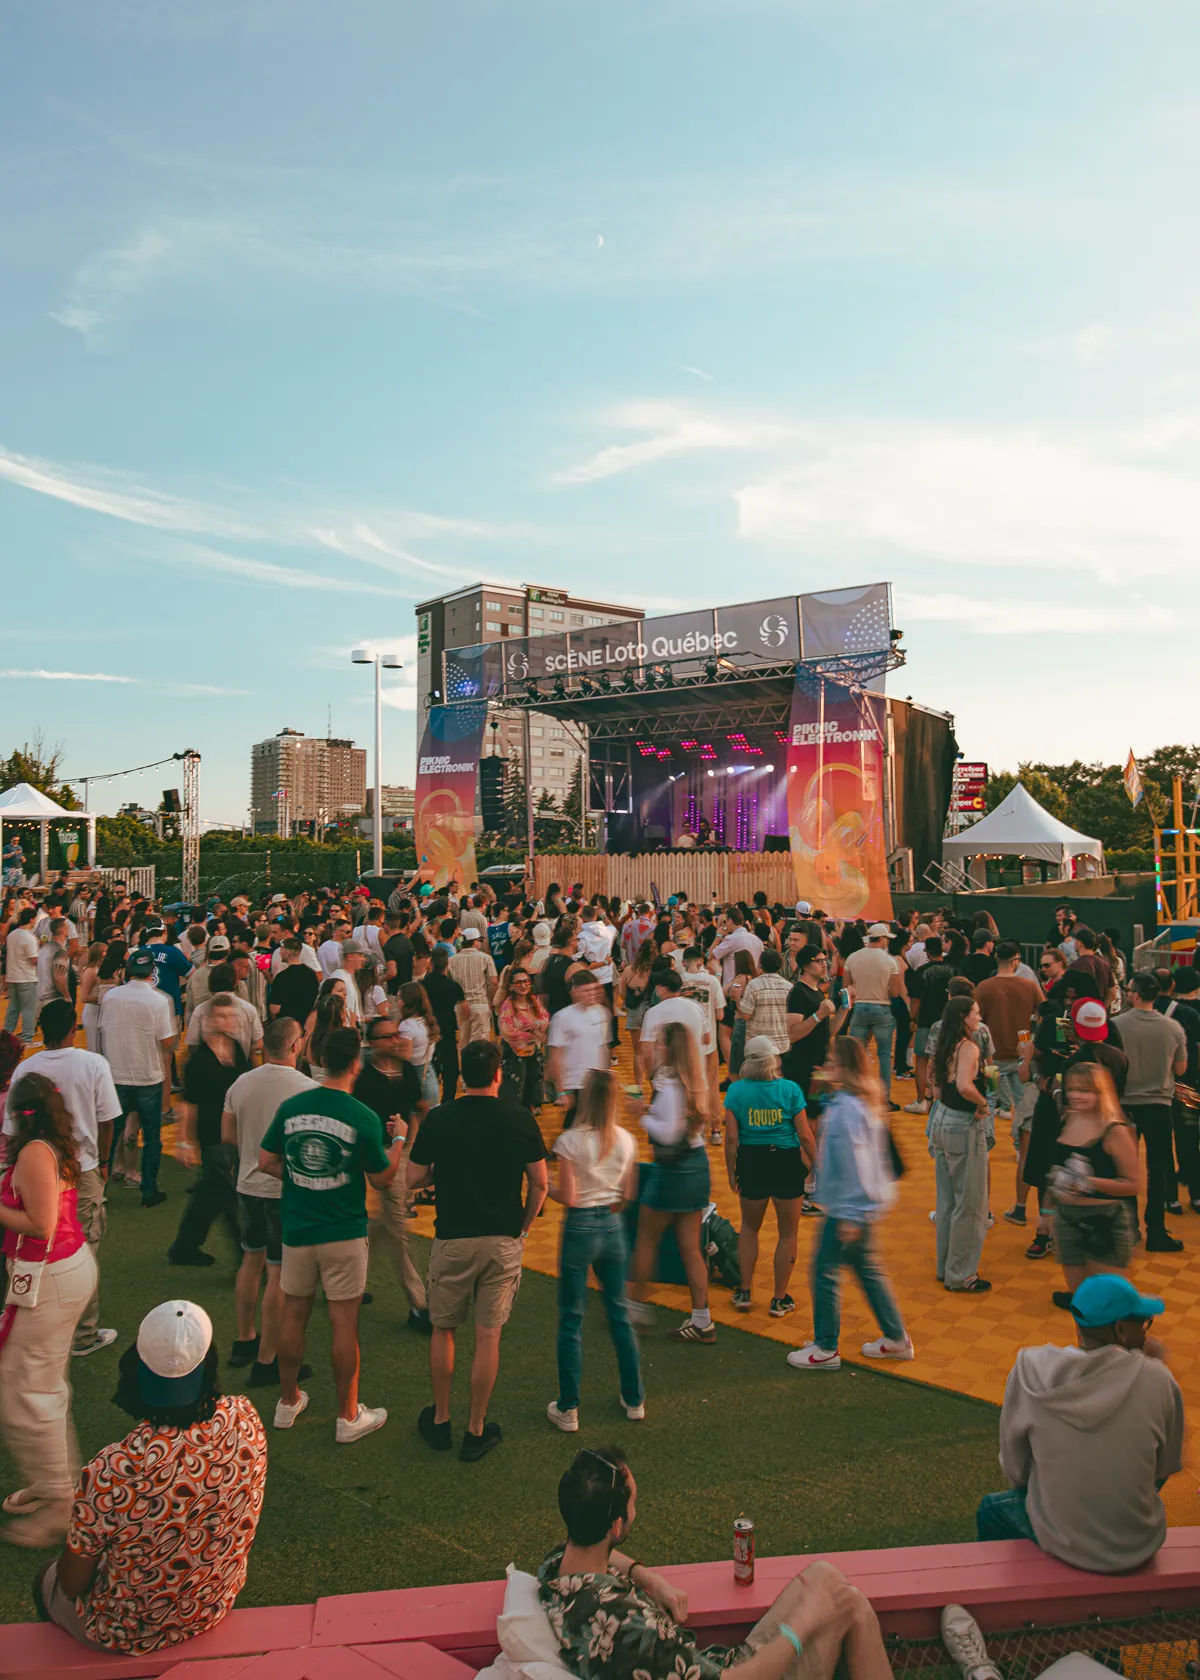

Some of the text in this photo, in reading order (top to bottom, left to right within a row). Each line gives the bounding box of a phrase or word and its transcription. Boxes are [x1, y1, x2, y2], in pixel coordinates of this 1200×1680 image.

[545, 631, 738, 672] SCÈNE Loto Québec
[793, 721, 839, 735] PIKNIC
[420, 756, 450, 765] PIKNIC
